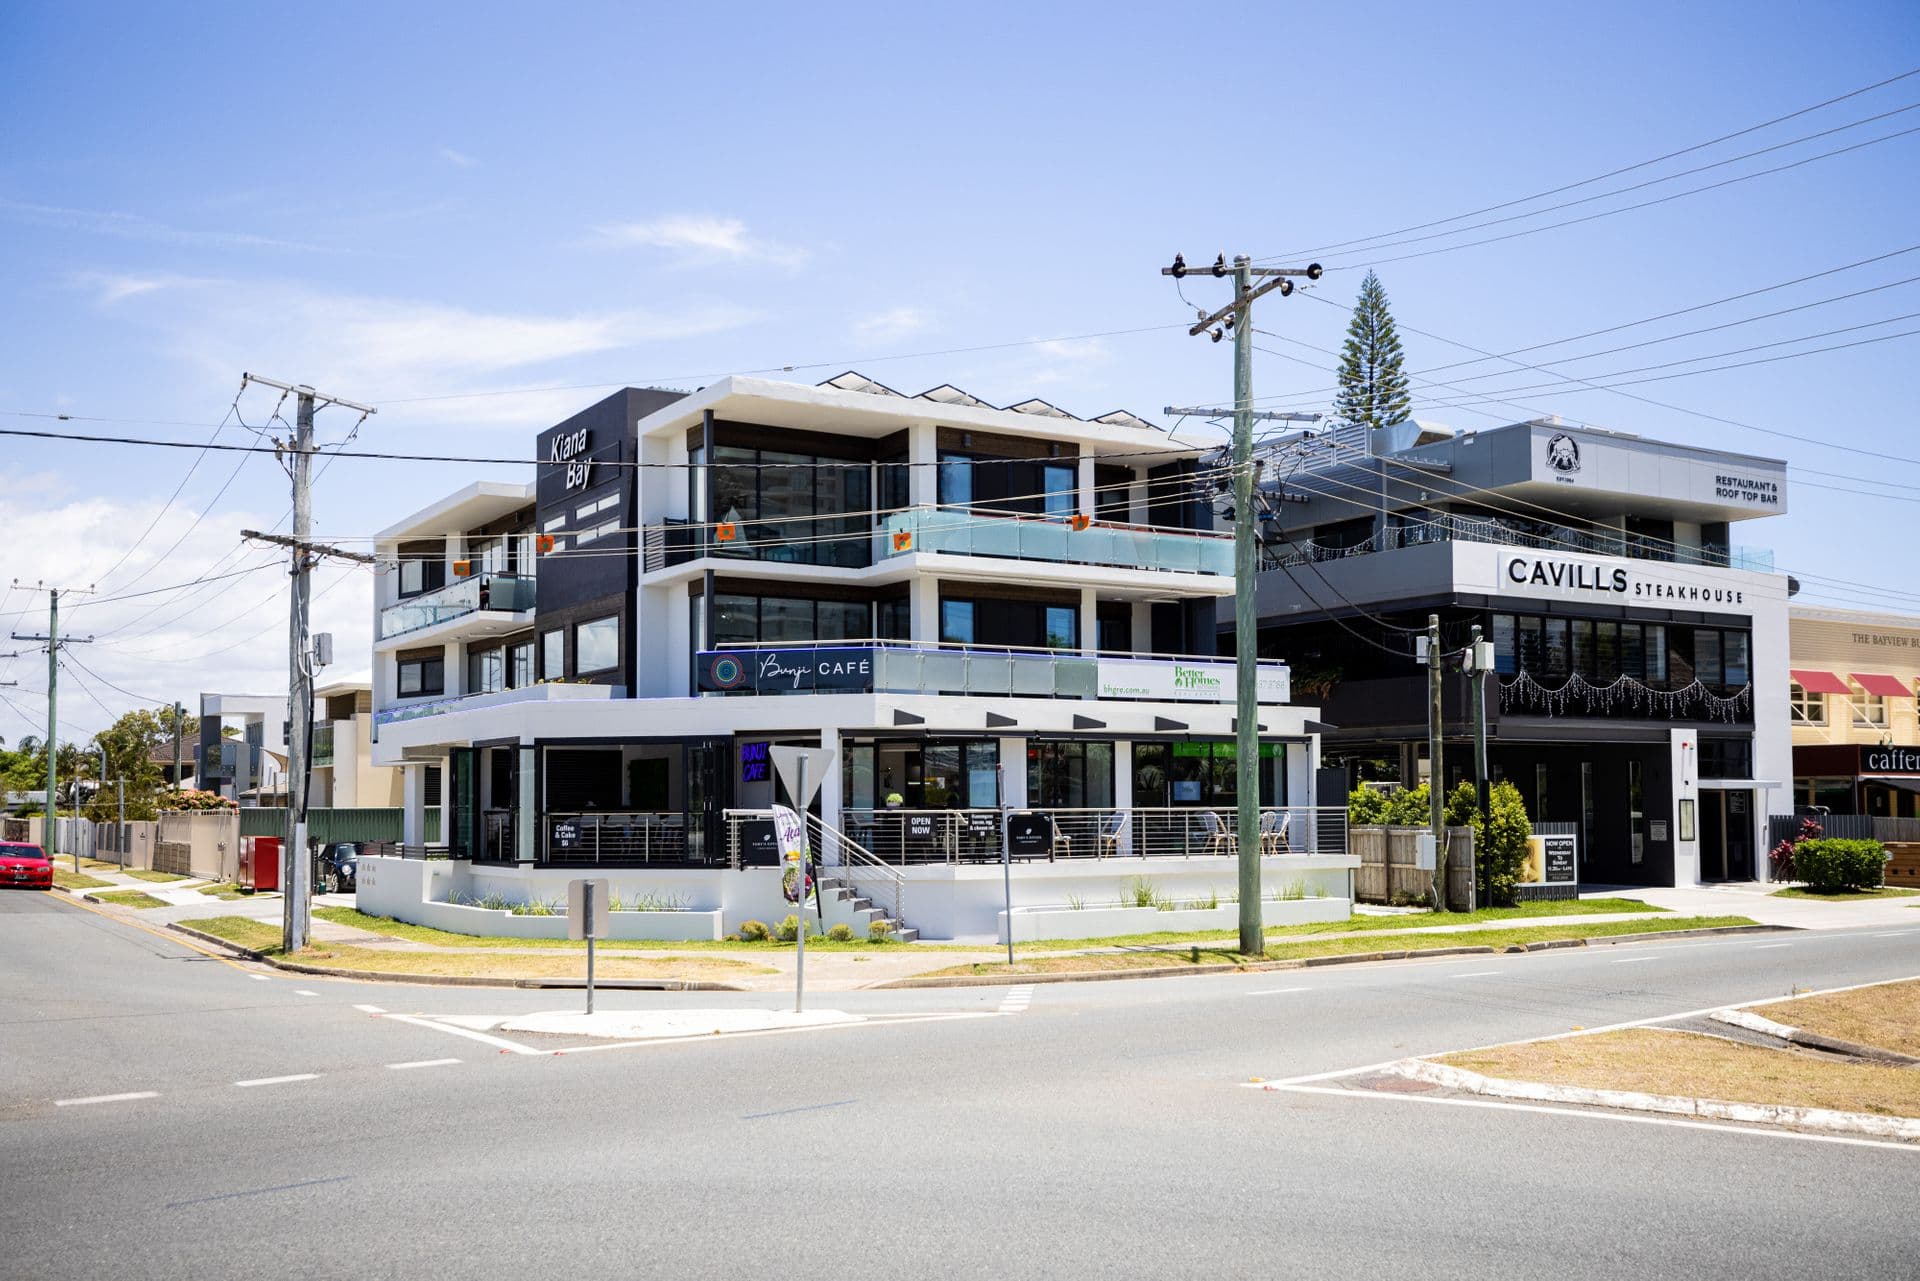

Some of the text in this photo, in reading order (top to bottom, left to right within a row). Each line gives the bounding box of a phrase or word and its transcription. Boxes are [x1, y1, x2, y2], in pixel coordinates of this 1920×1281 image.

[551, 428, 587, 466] Kiana
[566, 457, 592, 490] Bay
[1716, 475, 1777, 492] RESTAURANT &
[1716, 487, 1778, 504] ROOF TOP BAR
[1508, 558, 1743, 604] CAVILLS STEAKHOUSE
[1852, 633, 1870, 644] THE
[1872, 634, 1909, 647] BAYVIEW
[760, 653, 870, 688] Bunji CAFÉ
[1175, 665, 1205, 677] Better
[1103, 682, 1150, 696] bhgre.com.au
[1185, 677, 1221, 688] Homes
[911, 817, 931, 825] OPEN
[911, 826, 931, 834] NOW
